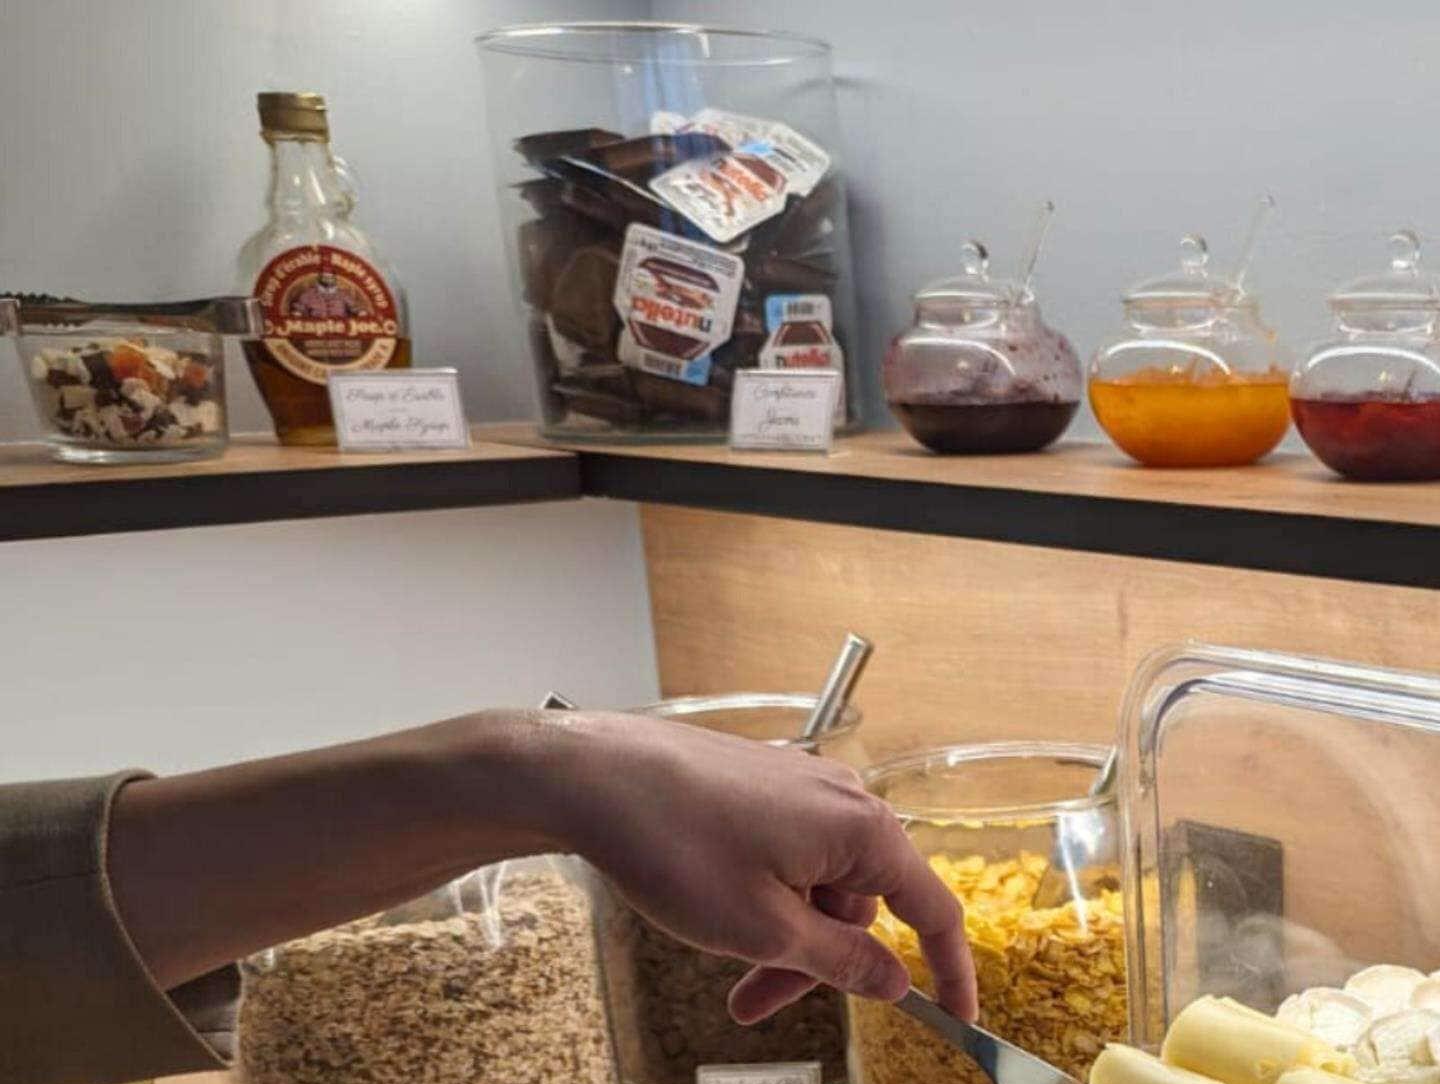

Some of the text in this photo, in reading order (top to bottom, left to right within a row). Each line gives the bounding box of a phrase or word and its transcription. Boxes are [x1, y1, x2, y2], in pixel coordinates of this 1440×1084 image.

[630, 296, 713, 334] nutella
[276, 320, 346, 337] Maple
[775, 347, 831, 368] nutella
